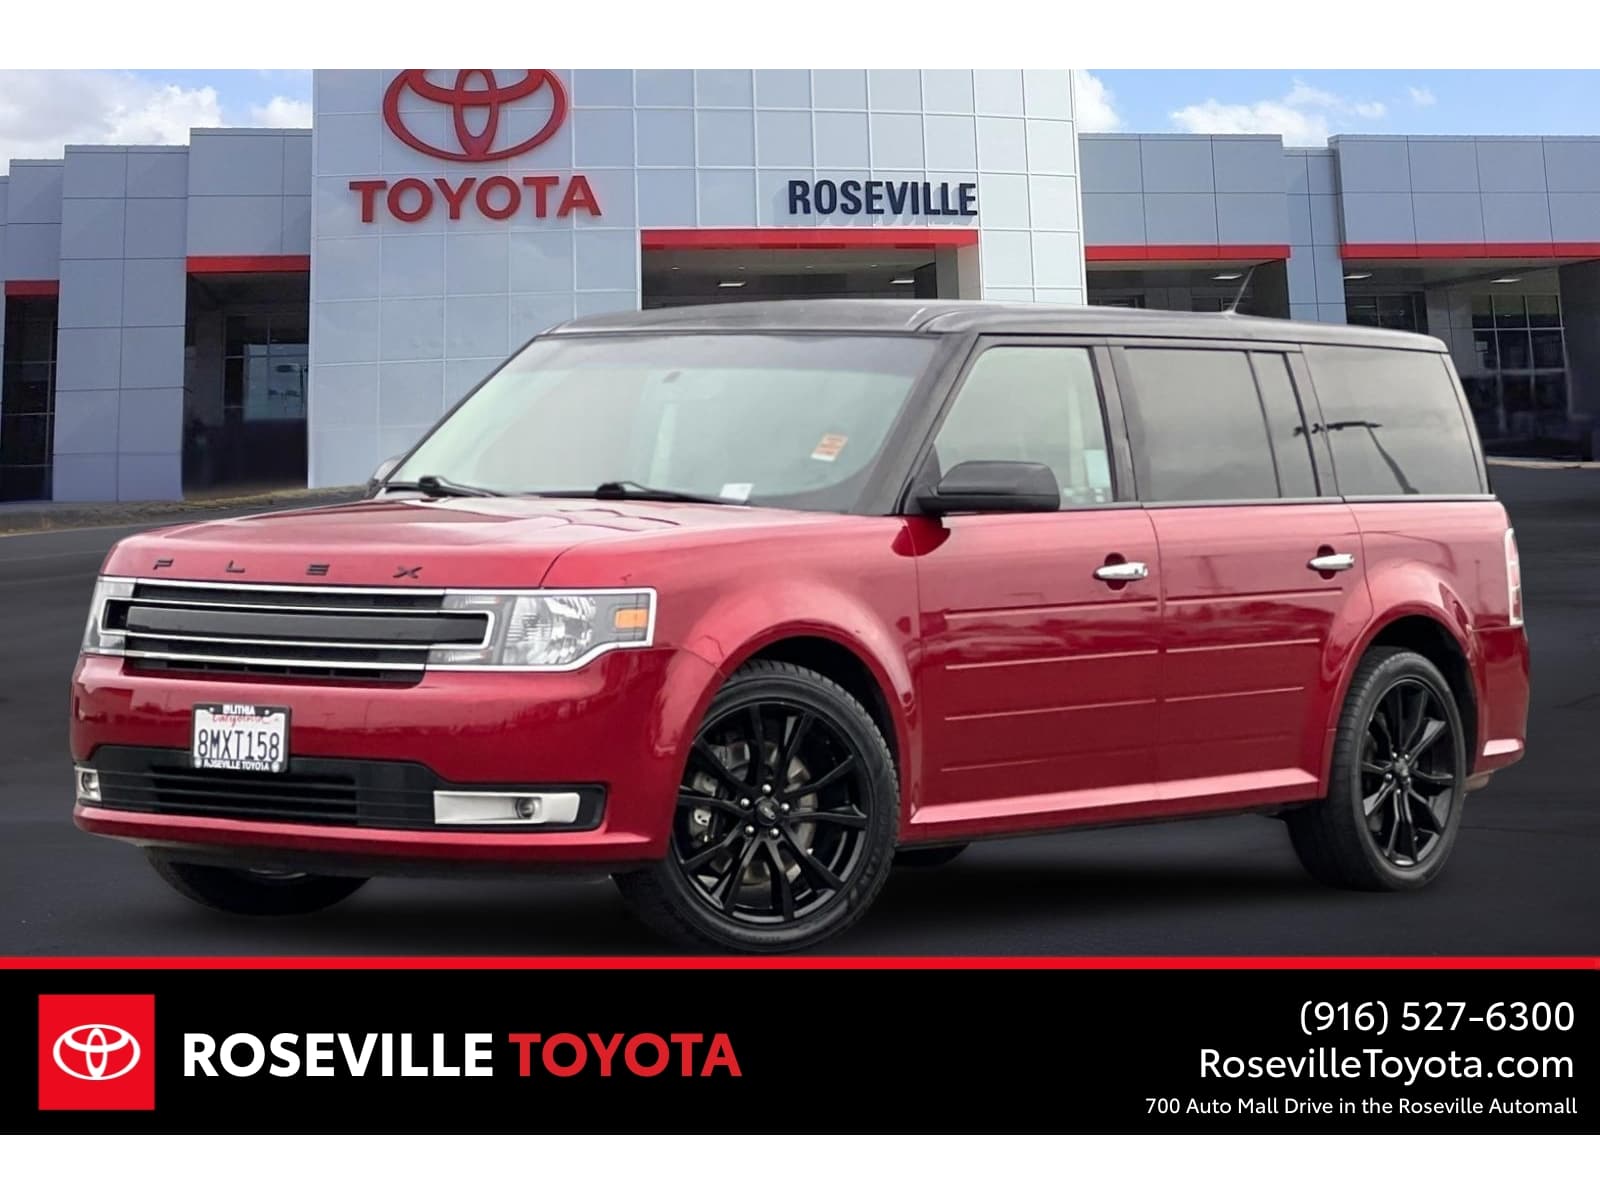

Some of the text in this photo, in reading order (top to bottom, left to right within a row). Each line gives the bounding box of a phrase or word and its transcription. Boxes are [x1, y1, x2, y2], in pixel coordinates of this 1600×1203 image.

[349, 175, 602, 223] TOYOTA
[788, 180, 978, 216] ROSEVILLE
[198, 728, 280, 761] 8MXT158
[242, 761, 269, 771] TOYOTA
